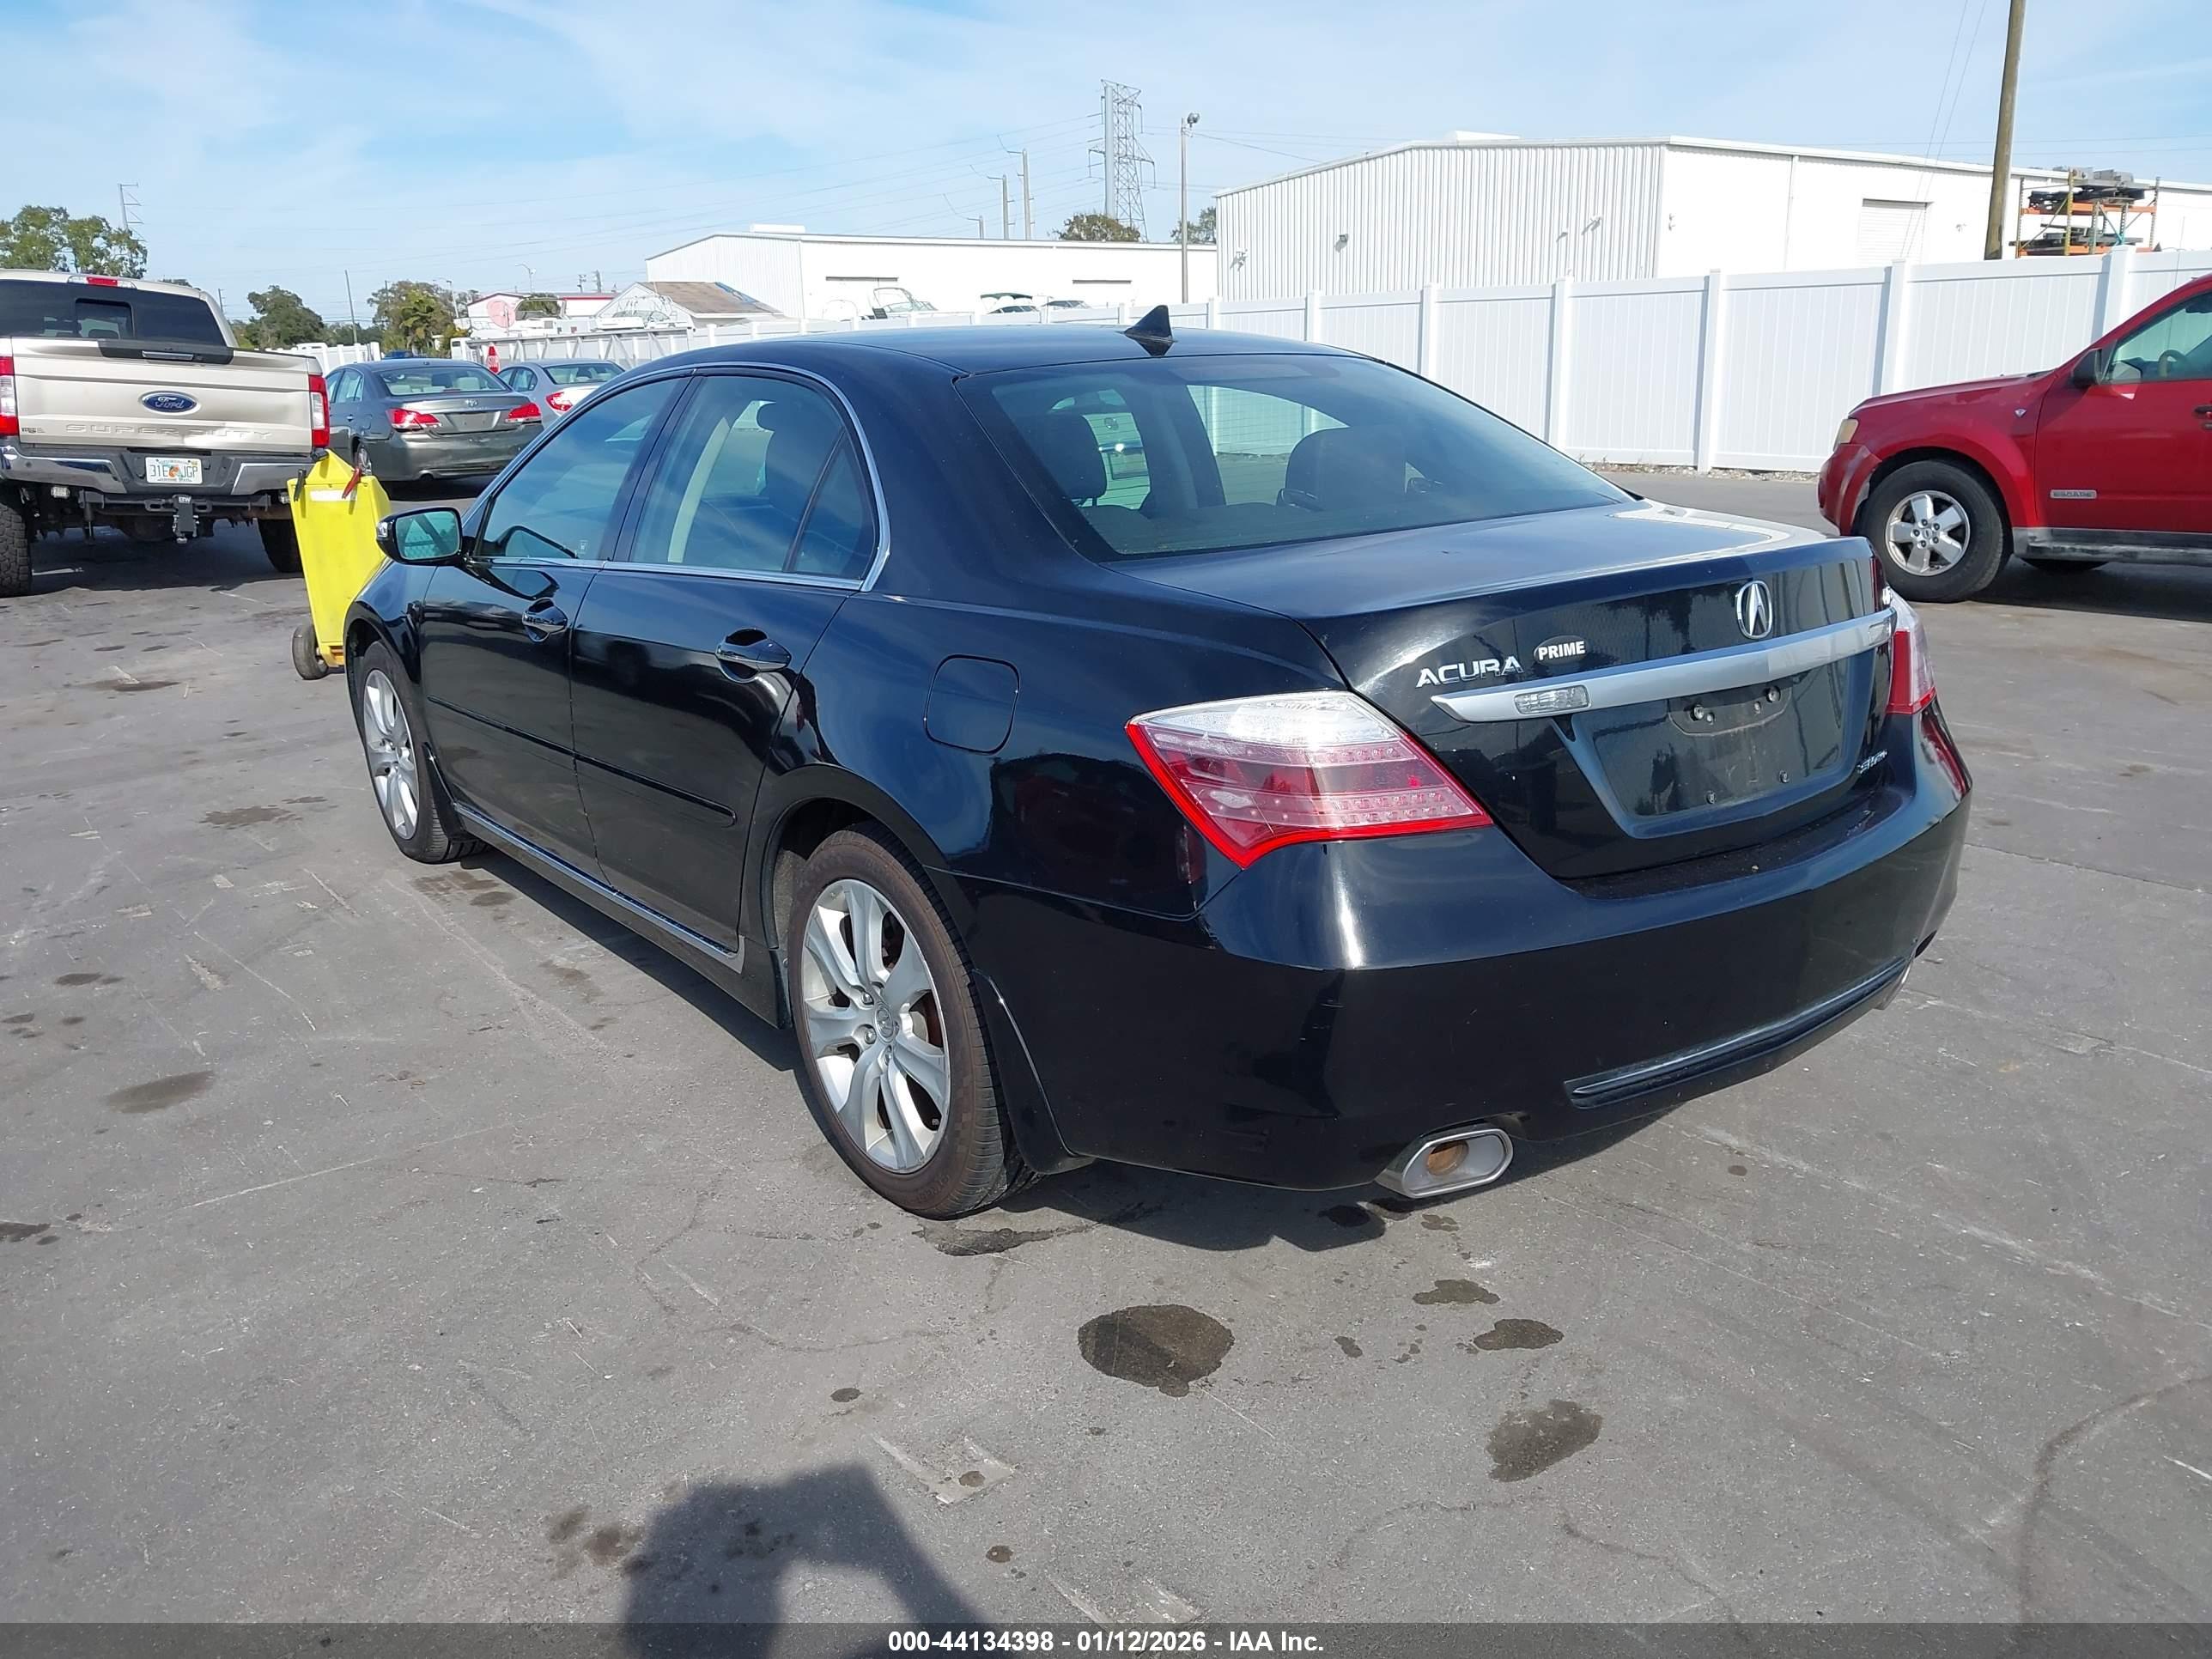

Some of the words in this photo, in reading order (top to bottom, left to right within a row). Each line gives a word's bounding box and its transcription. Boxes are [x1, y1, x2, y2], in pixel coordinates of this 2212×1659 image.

[155, 396, 185, 410] Ford
[65, 424, 179, 436] SUPER
[188, 428, 273, 441] DUTY
[1538, 641, 1586, 661] PRIME
[1416, 655, 1524, 688] ACURA
